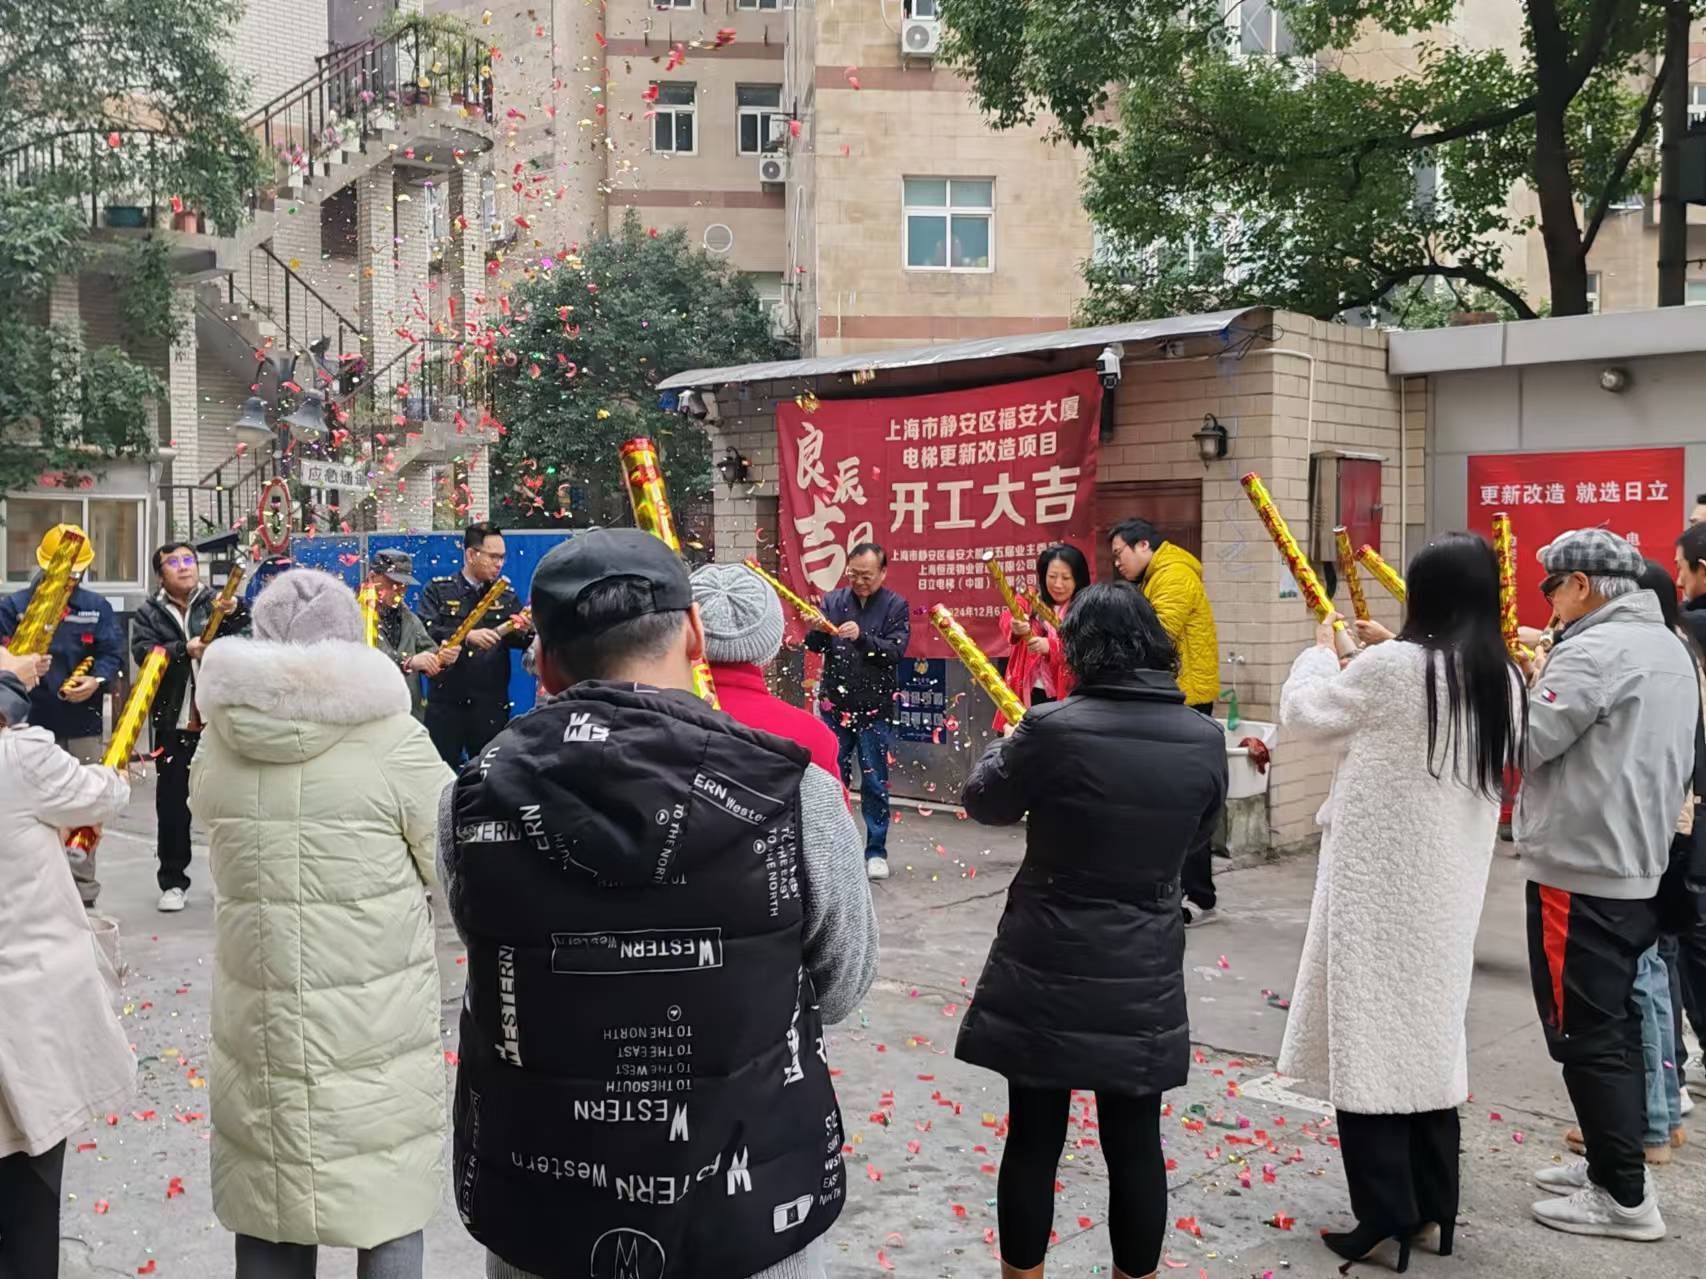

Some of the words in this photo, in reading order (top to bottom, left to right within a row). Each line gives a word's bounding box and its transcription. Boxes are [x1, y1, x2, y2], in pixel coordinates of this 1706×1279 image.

[884, 395, 1081, 442] 上海市静安区福安大厦
[902, 431, 1058, 470] 电梯更新改造项目
[889, 465, 1081, 534] 开工大吉
[1480, 482, 1566, 506] 更新改造
[1575, 480, 1669, 504] 就选日立
[768, 870, 779, 917] NORTH
[620, 936, 715, 967] WESTERN
[495, 944, 524, 1068] WESTERN
[603, 1026, 648, 1041] NORTH
[650, 1025, 675, 1040] THE
[676, 1025, 694, 1038] TO
[617, 1045, 648, 1059] EAST
[650, 1044, 675, 1058] THE
[676, 1043, 694, 1056] TO
[615, 1064, 648, 1076] WEST
[650, 1063, 675, 1075] THE
[676, 1062, 694, 1074] TO
[676, 1079, 693, 1091] TO
[574, 1099, 690, 1142] WESTERN
[511, 1151, 608, 1188] Western
